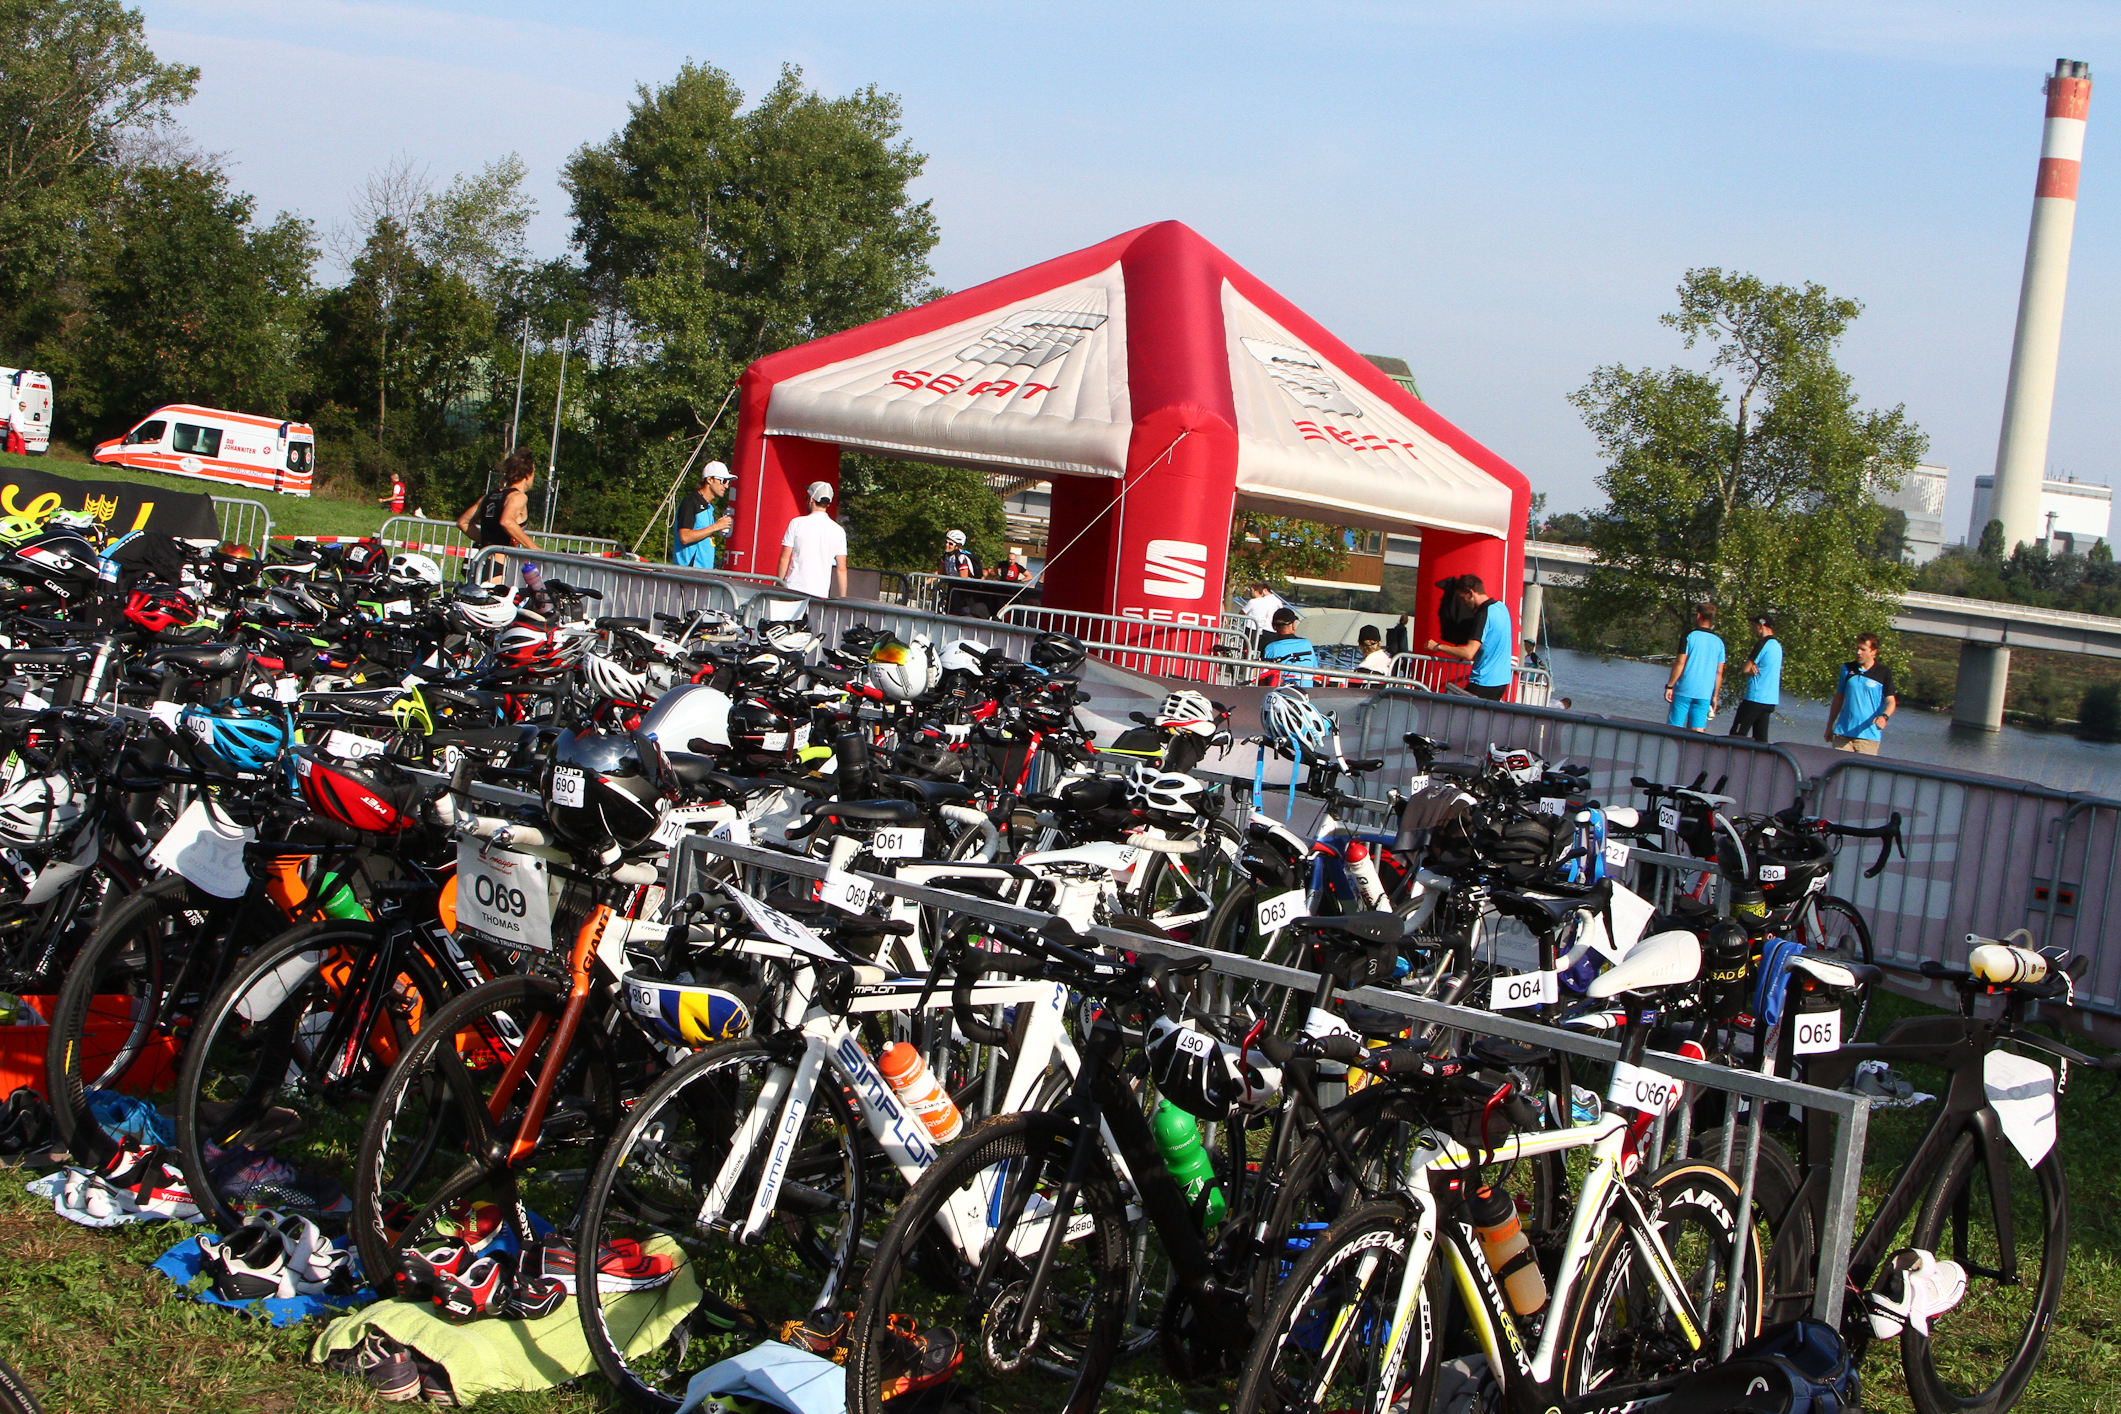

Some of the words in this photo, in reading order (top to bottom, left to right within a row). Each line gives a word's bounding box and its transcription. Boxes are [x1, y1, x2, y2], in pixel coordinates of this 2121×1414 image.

[888, 368, 1059, 400] SEAT
[224, 444, 257, 455] JOHANNITER
[226, 438, 235, 446] DIE
[44, 578, 71, 599] GIRO
[360, 796, 389, 816] MET
[1540, 801, 1554, 814] O19
[875, 832, 903, 850] O61
[474, 874, 527, 918] O69
[845, 884, 866, 908] O69
[481, 911, 520, 932] THOMAS
[1259, 905, 1287, 926] O63
[480, 932, 500, 945] VIENNA
[500, 939, 533, 952] TRIATHLON
[582, 909, 611, 973] GIANT
[1508, 983, 1542, 1000] O64
[1799, 1023, 1832, 1044] O65
[1635, 1079, 1668, 1106] O66
[760, 1098, 803, 1209] SIMPLON
